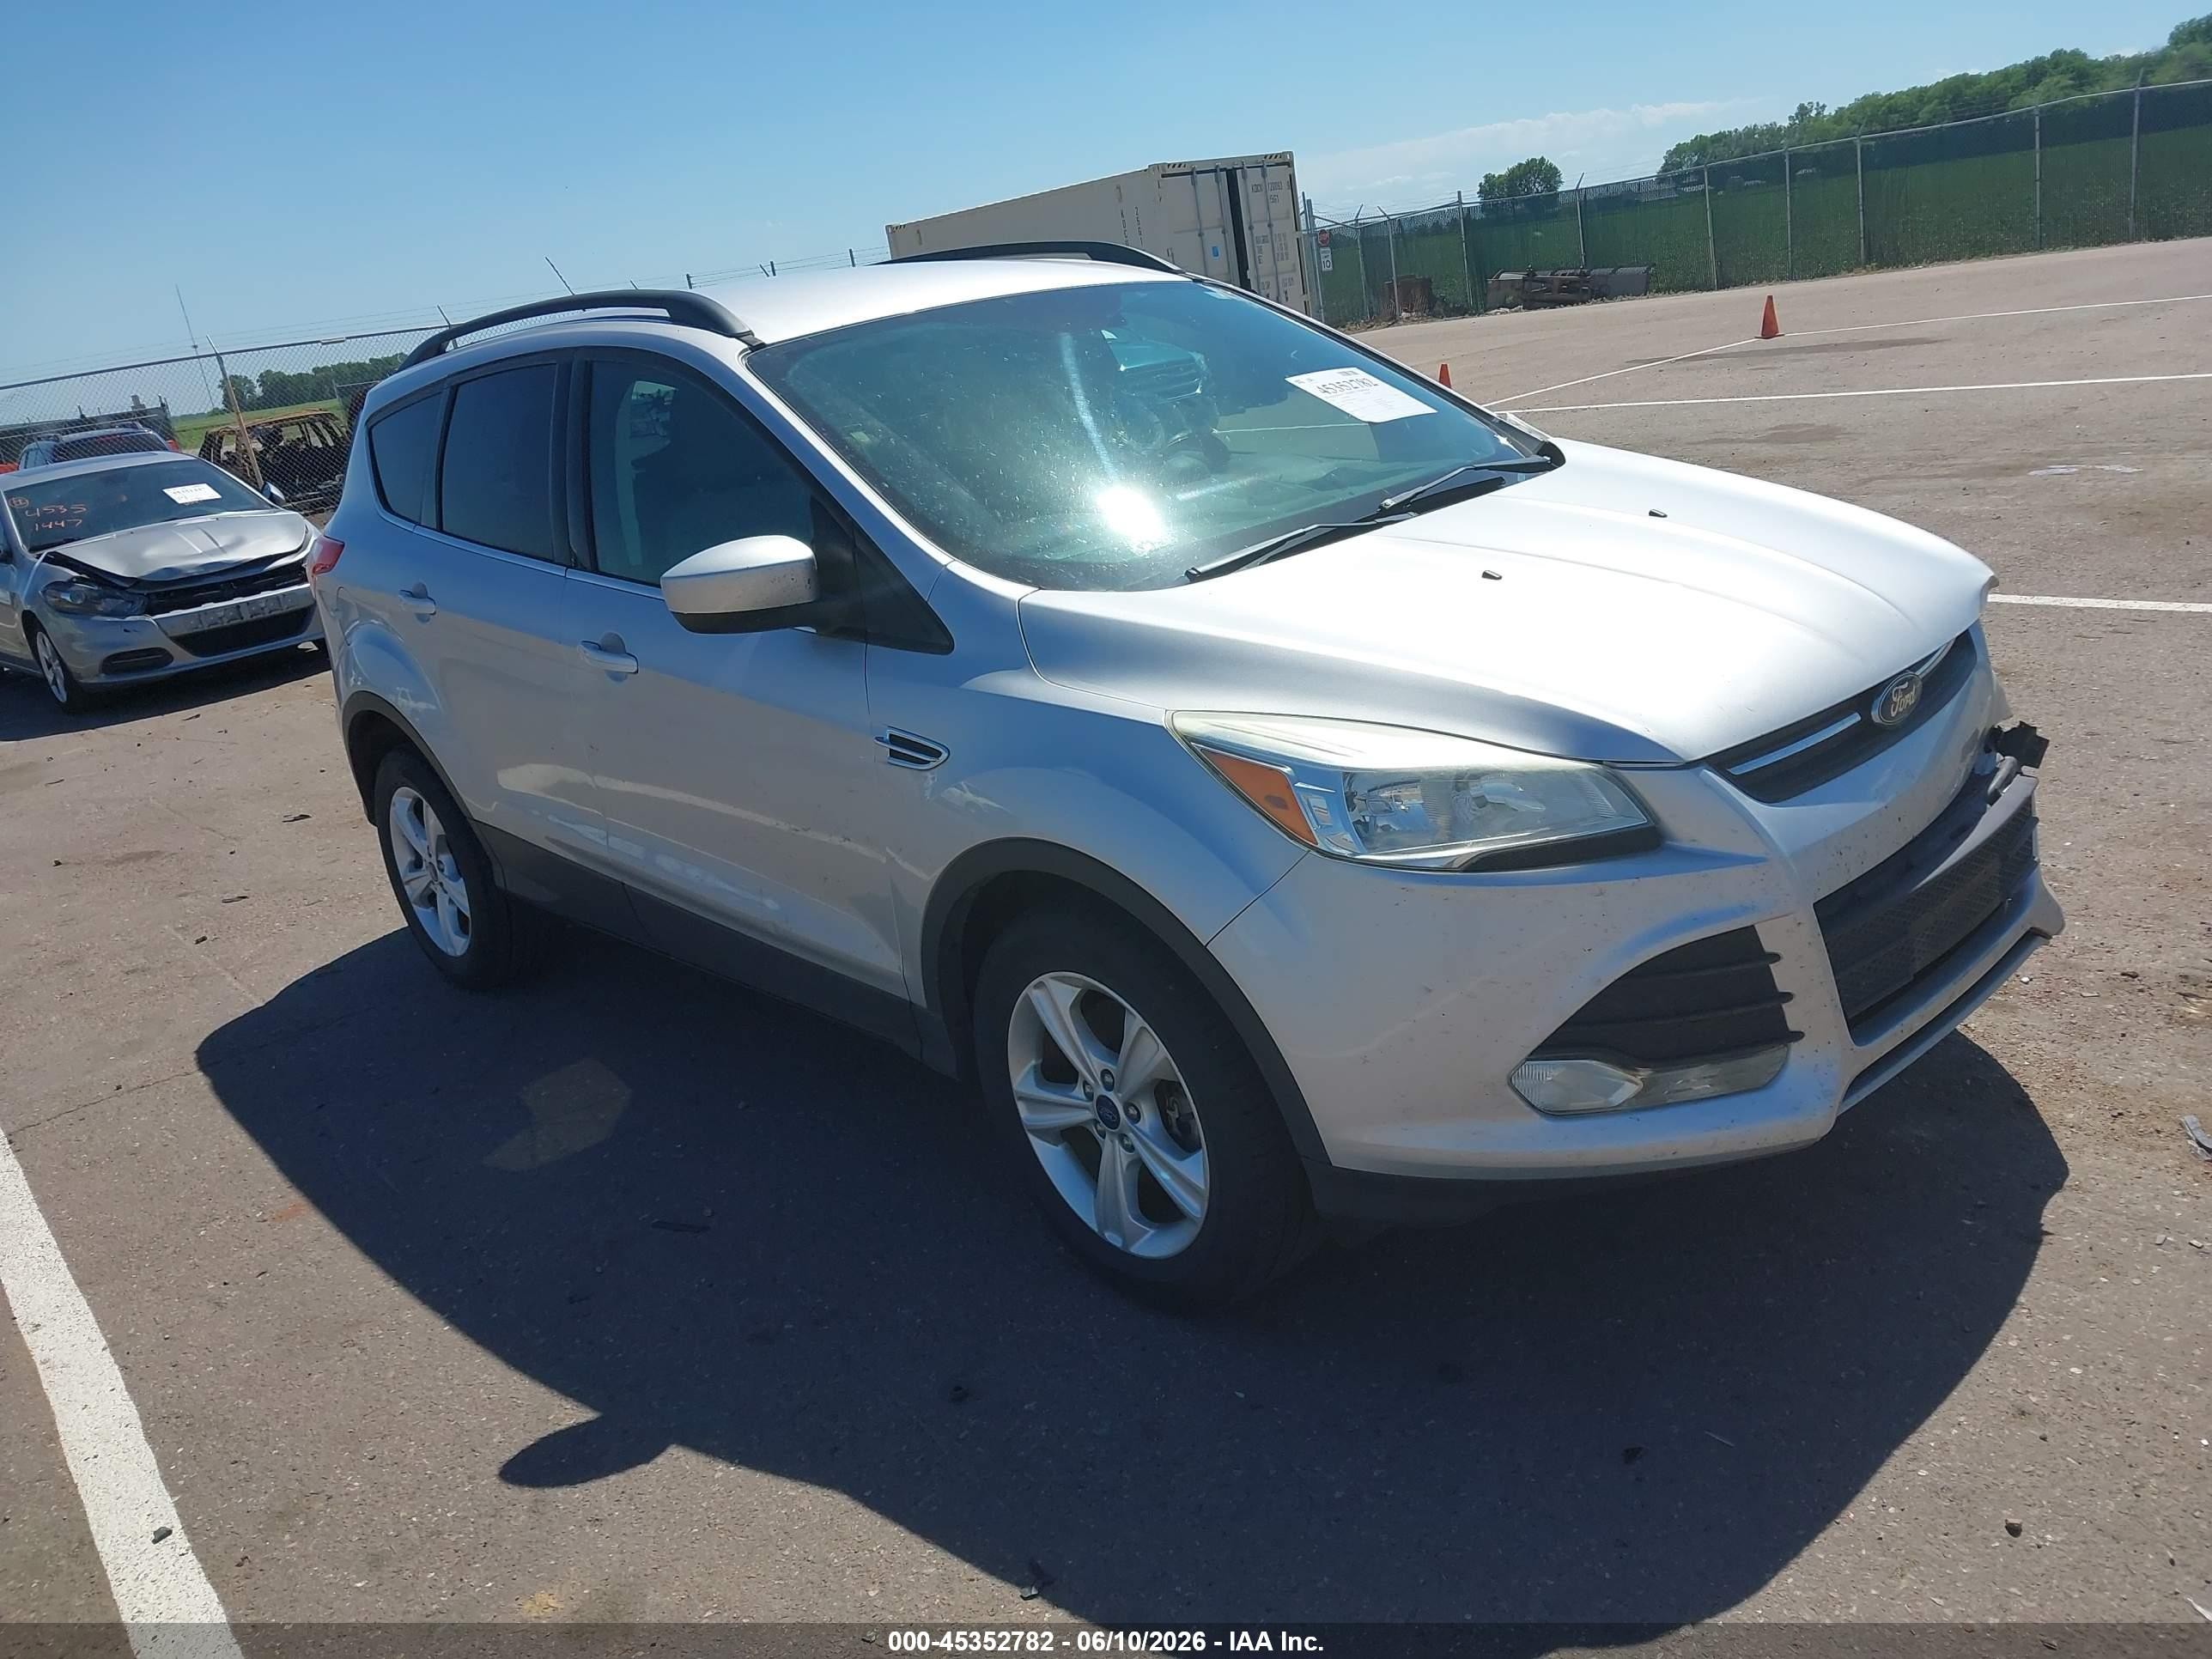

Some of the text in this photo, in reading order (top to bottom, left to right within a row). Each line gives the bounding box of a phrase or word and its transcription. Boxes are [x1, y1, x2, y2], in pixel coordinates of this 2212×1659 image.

[1322, 259, 1331, 269] 10
[1316, 378, 1379, 395] 45352782
[25, 504, 88, 517] 4535
[35, 519, 82, 532] 1447
[1890, 681, 1917, 717] Ford
